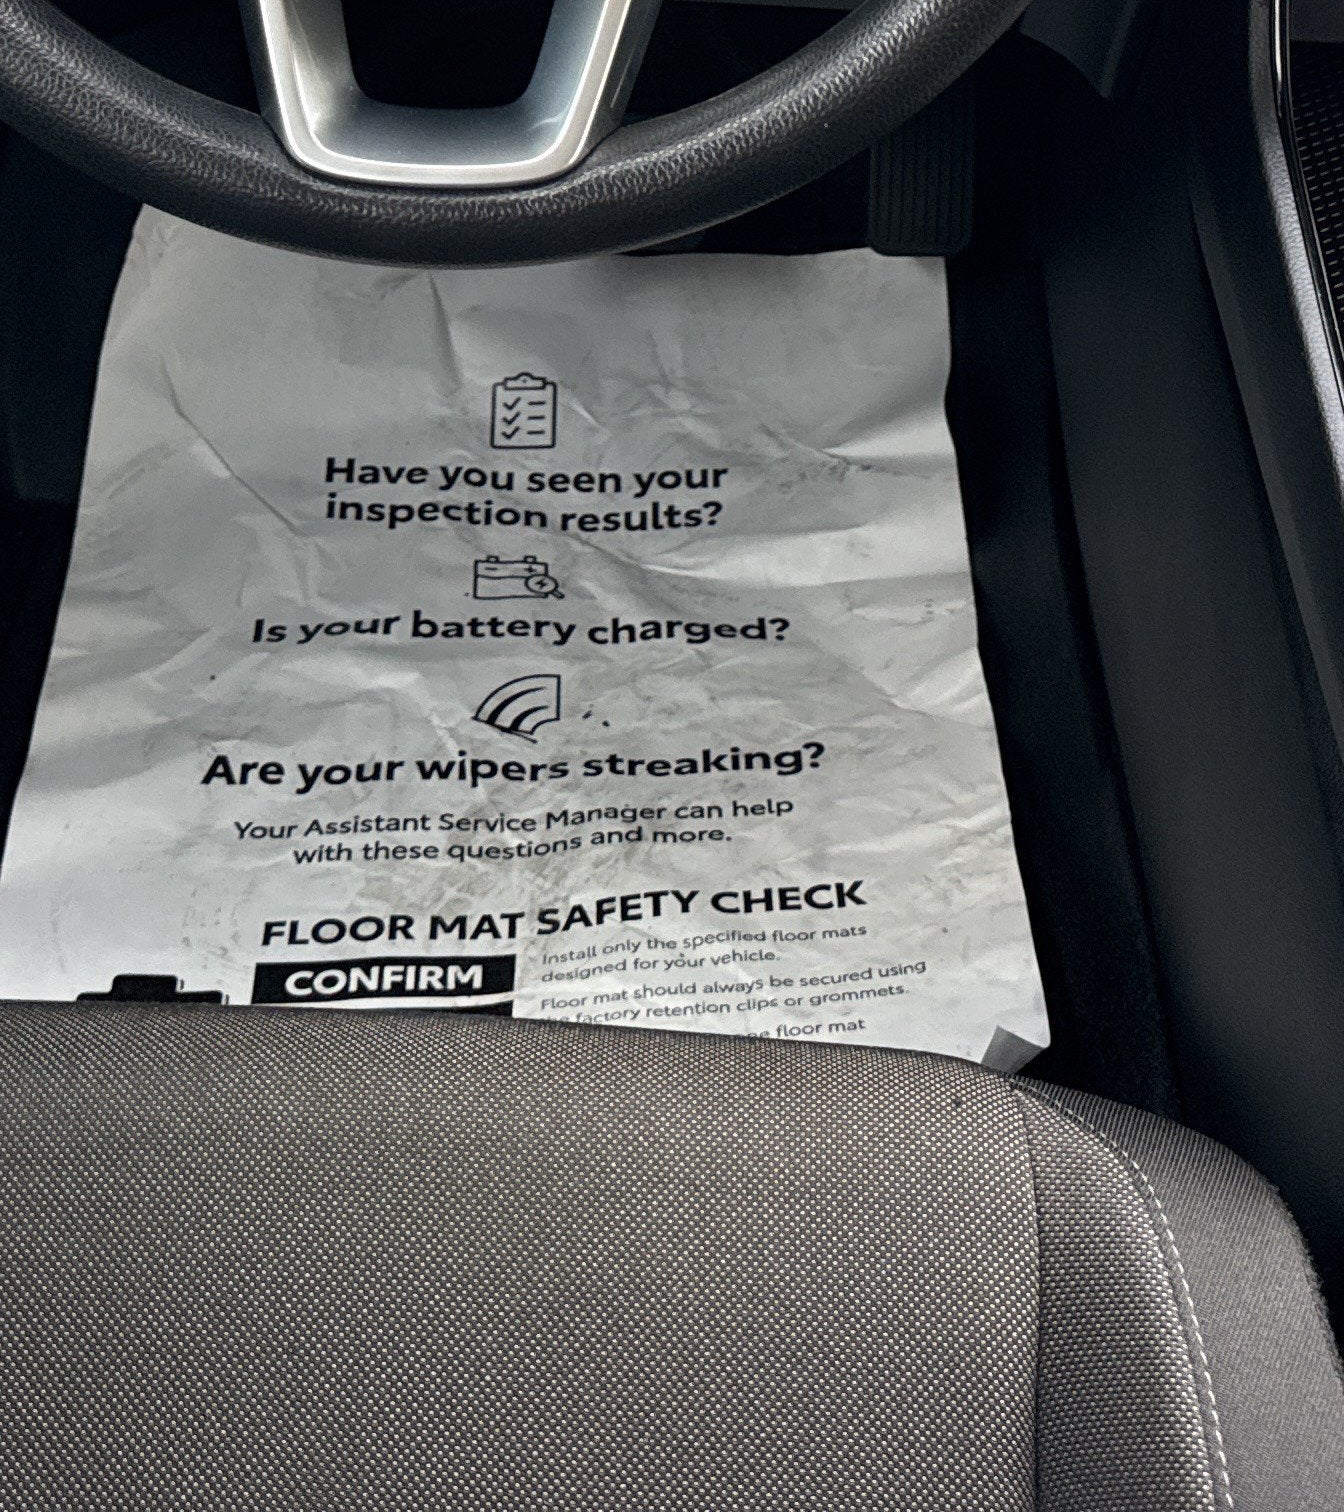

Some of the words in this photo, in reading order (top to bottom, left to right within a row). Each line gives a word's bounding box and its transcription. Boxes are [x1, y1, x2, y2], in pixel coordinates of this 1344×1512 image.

[324, 457, 429, 486] Have
[439, 464, 515, 490] you
[527, 469, 622, 493] seen
[633, 466, 729, 498] your
[326, 492, 547, 529] inspection
[560, 501, 724, 533] results?
[253, 618, 288, 644] Is
[295, 615, 402, 645] your
[411, 610, 576, 646] battery
[587, 616, 793, 646] charged?
[201, 754, 285, 786] Are
[297, 759, 406, 795] your
[416, 749, 570, 788] wipers
[582, 741, 826, 777] streaking?
[234, 821, 298, 840] Your
[303, 813, 432, 837] Assistant
[438, 812, 537, 834] Service
[546, 802, 668, 829] Manager
[675, 804, 723, 820] can
[732, 798, 794, 818] help
[294, 842, 353, 865] with
[362, 840, 440, 862] these
[447, 834, 582, 863] questions
[590, 825, 643, 846] and
[652, 826, 733, 844] more.
[261, 914, 415, 946] FLOOR
[429, 911, 525, 940] MAT
[536, 889, 701, 936] SAFETY
[711, 879, 868, 914] CHECK
[542, 946, 597, 966] Install
[602, 938, 642, 957] only
[647, 934, 677, 951] the
[682, 930, 767, 951] specified
[772, 925, 817, 943] floor
[822, 924, 867, 938] mats
[284, 963, 483, 997] CONFIRM
[540, 958, 627, 983] designed
[633, 955, 660, 970] for
[663, 953, 706, 972] your
[710, 949, 782, 966] vehicle.
[540, 995, 588, 1012] Floor
[593, 989, 629, 1005] mat
[633, 982, 697, 1000] should
[703, 977, 764, 995] always
[769, 975, 795, 989] be
[799, 968, 873, 987] secured
[878, 960, 927, 980] using
[645, 1000, 731, 1018] retention
[736, 995, 778, 1014] clips
[784, 995, 805, 1007] or
[809, 985, 910, 1008] grommets.
[775, 1020, 831, 1039] floor
[834, 1019, 866, 1034] mat
